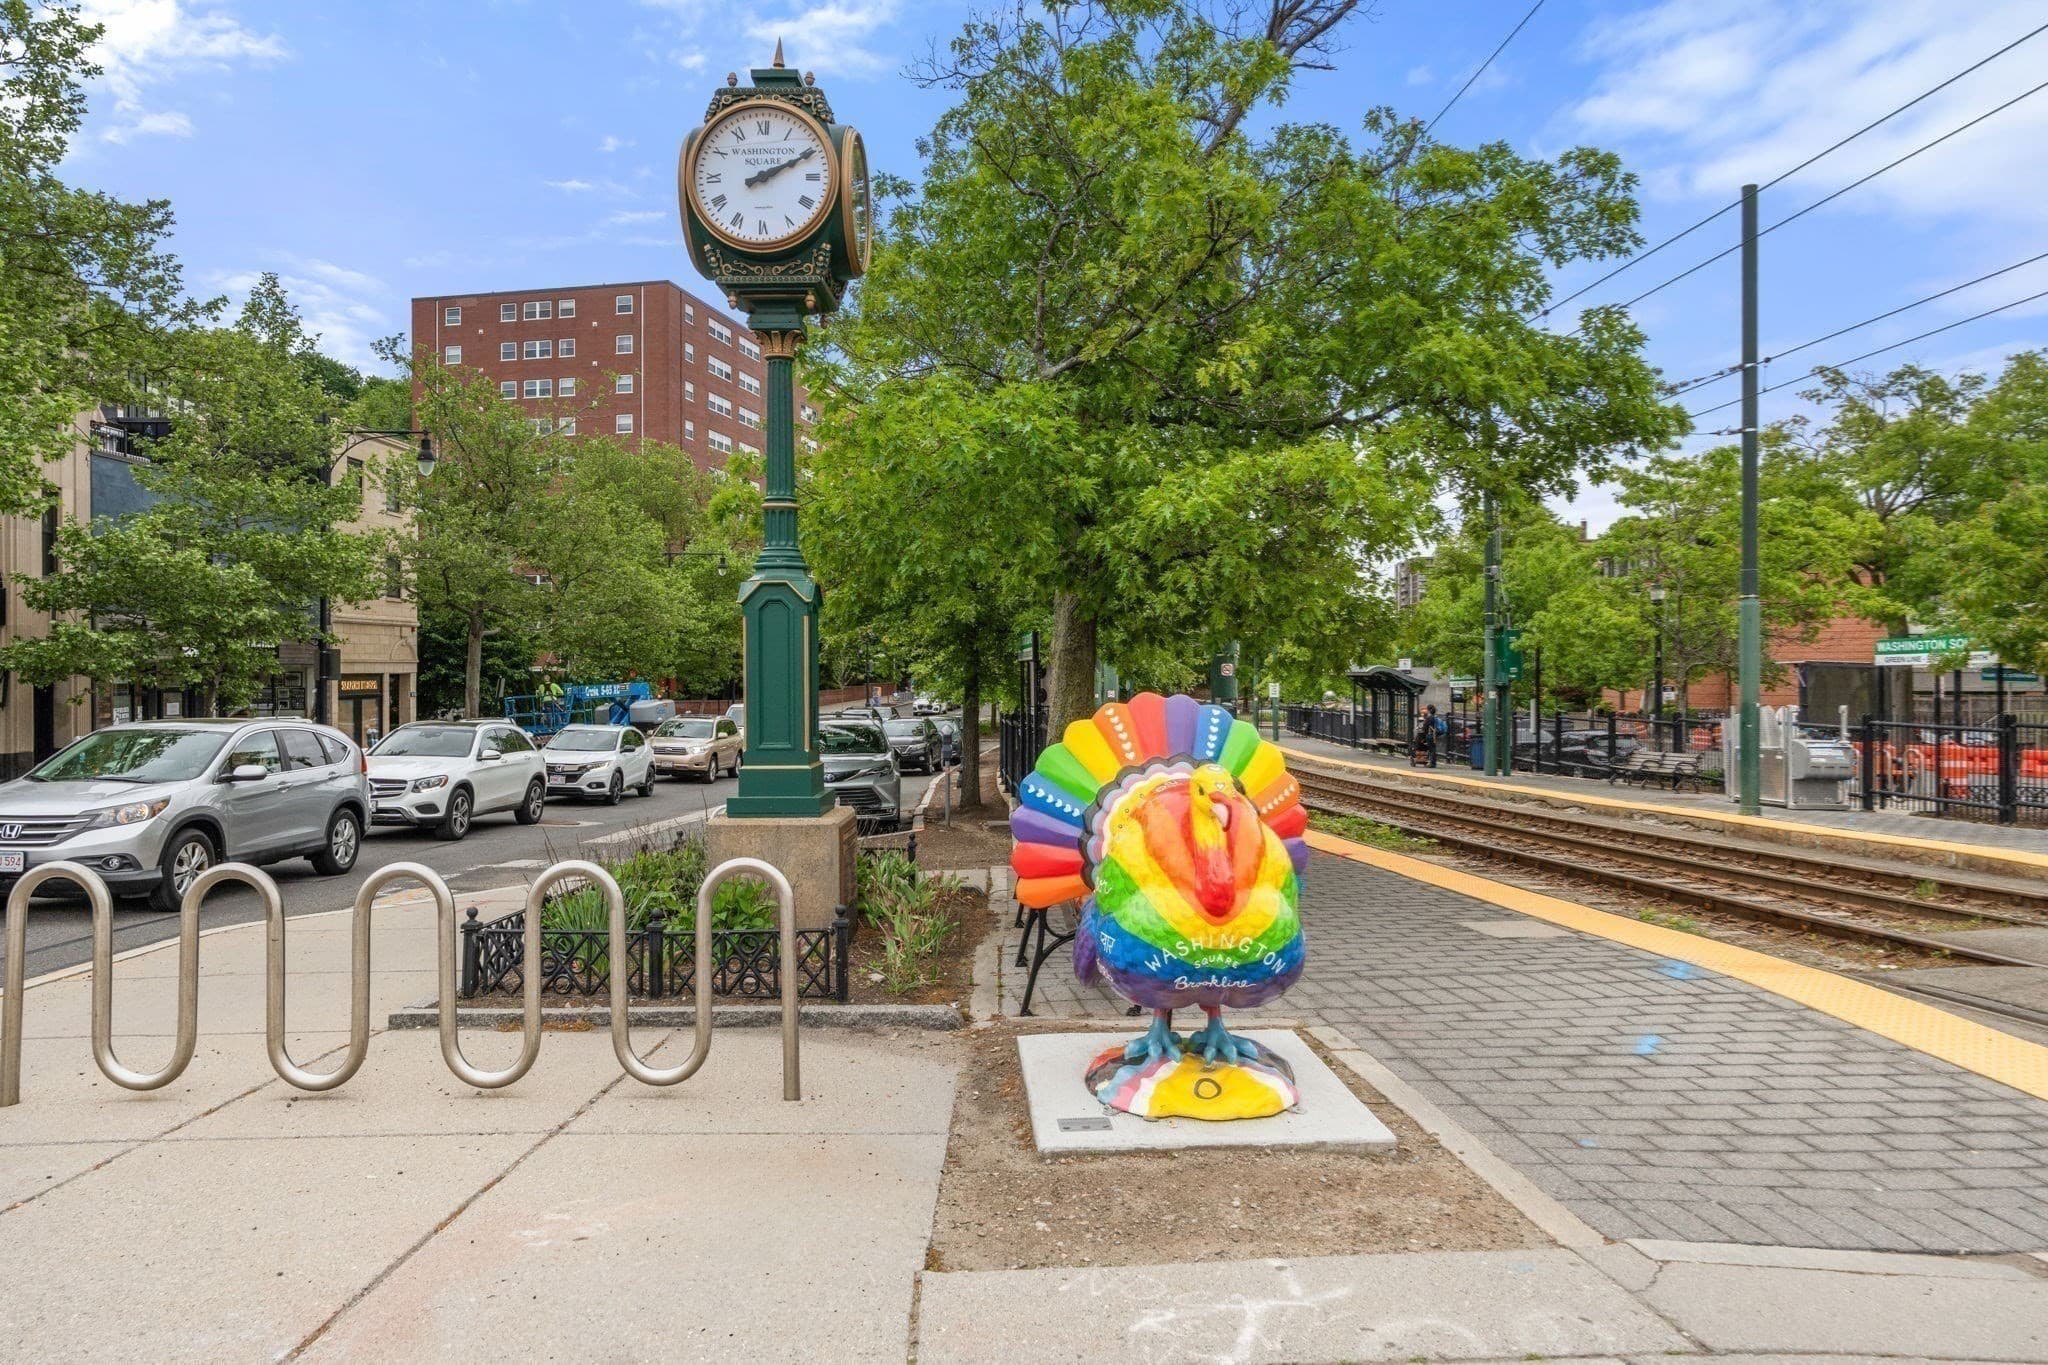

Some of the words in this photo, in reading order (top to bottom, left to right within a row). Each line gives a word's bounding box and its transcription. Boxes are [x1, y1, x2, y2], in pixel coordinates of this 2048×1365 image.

[731, 127, 746, 143] XI
[757, 120, 770, 136] XII
[732, 146, 795, 155] WASHINGTON
[744, 157, 783, 166] SQUARE
[1877, 639, 1947, 651] WASHINGTON
[1144, 935, 1286, 974] WASHINGTON
[1193, 954, 1240, 969] SQUARE
[1174, 974, 1257, 990] Brookline
